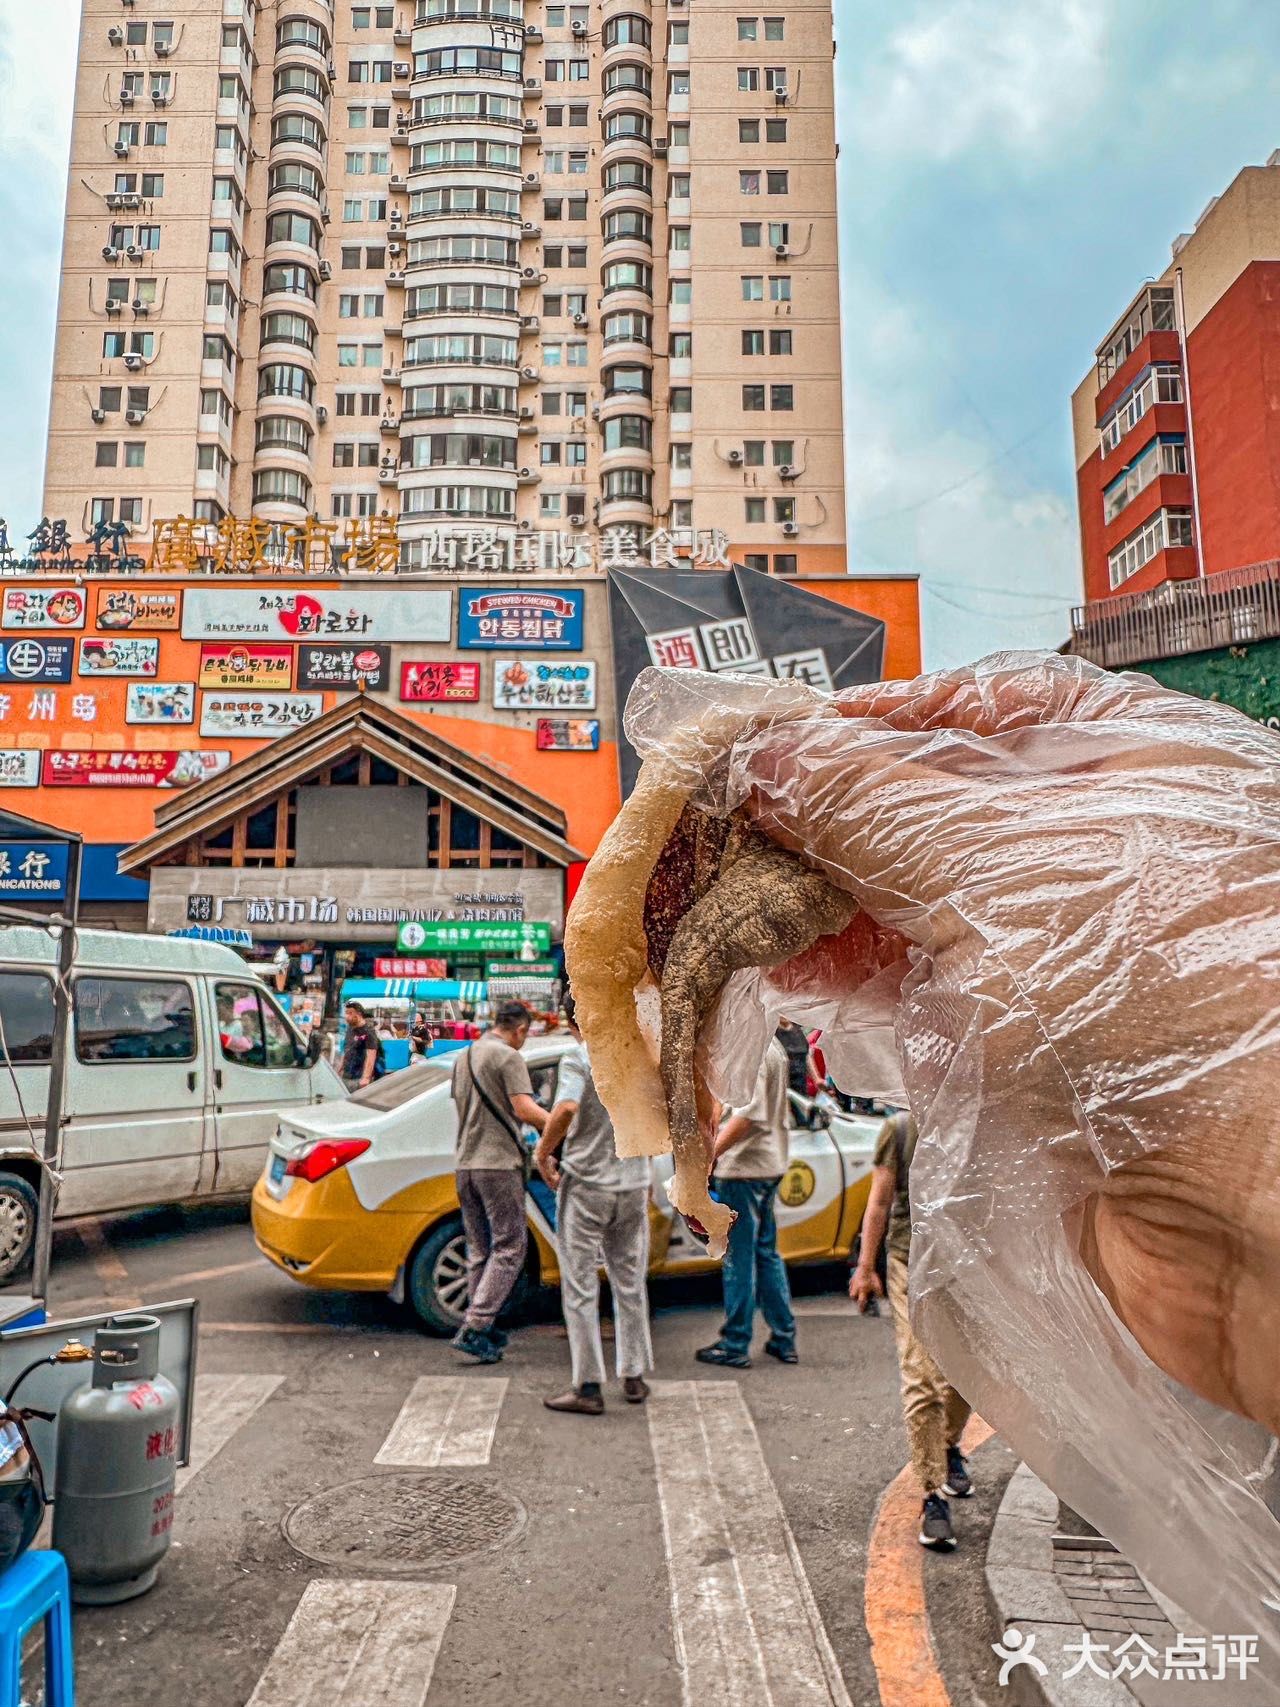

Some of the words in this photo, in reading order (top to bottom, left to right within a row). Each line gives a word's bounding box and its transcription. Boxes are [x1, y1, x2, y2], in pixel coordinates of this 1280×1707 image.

[420, 526, 731, 569] 西塔国际美食城
[478, 617, 565, 639] 안동찜닭
